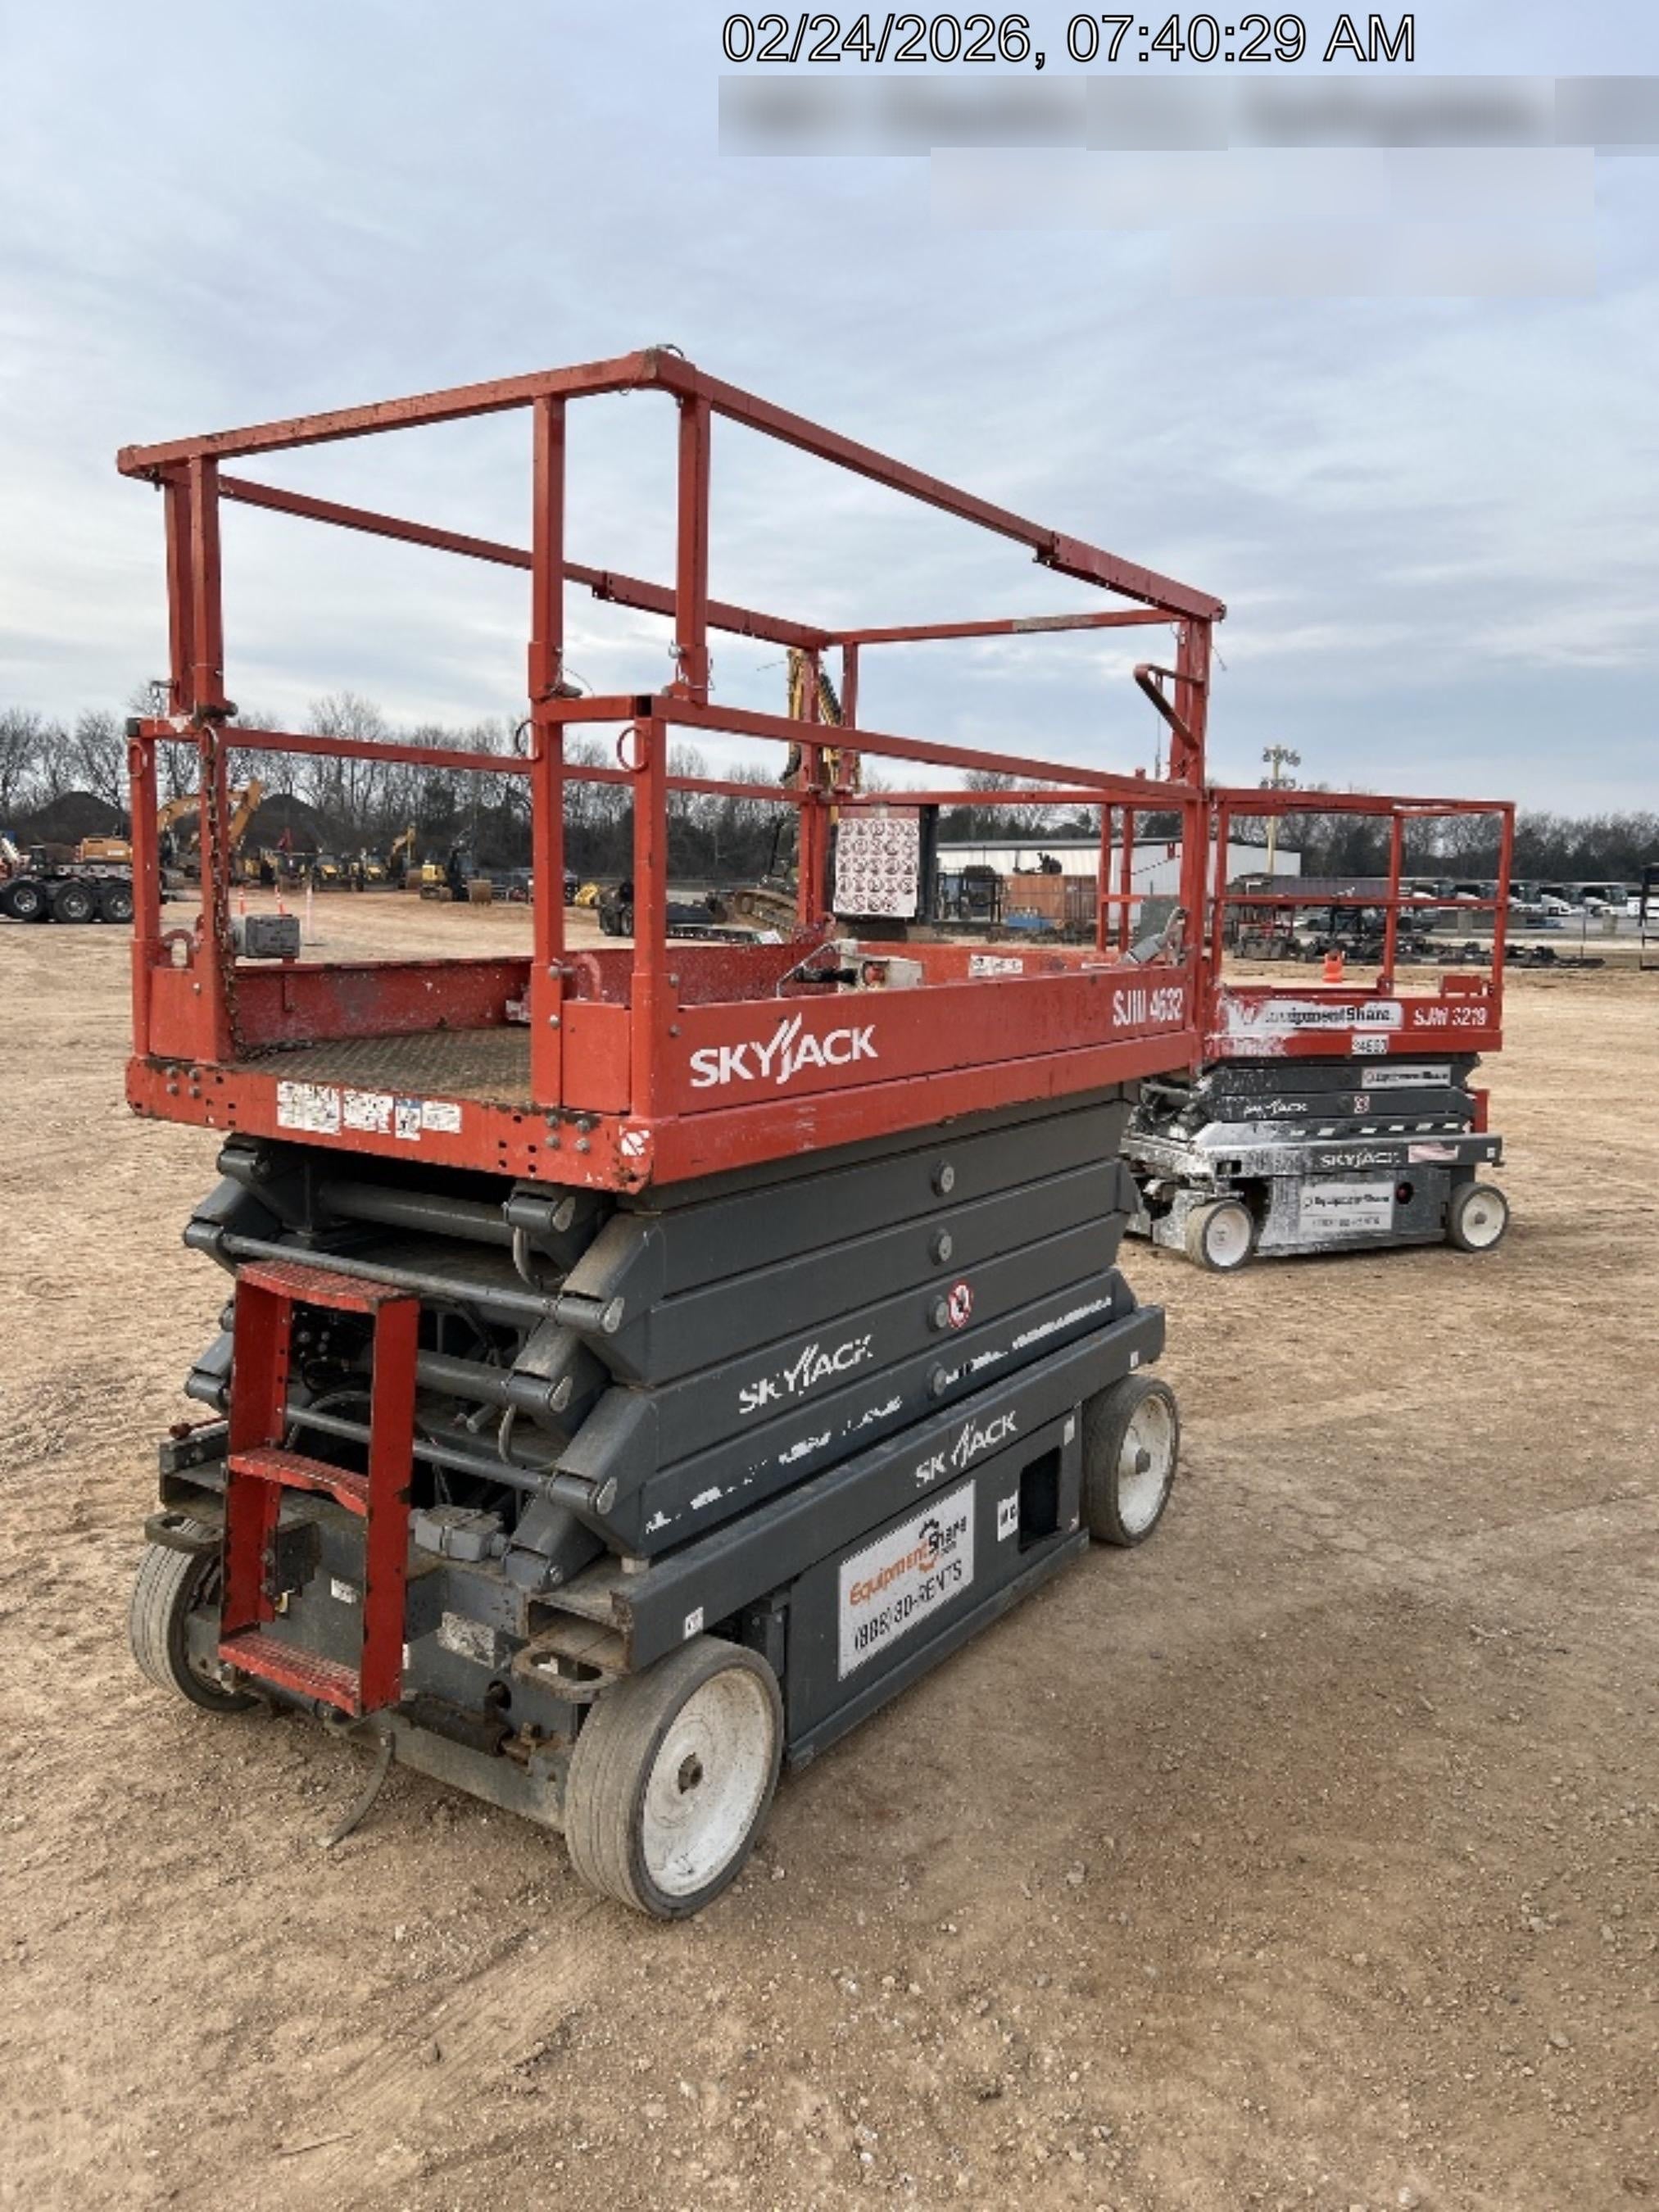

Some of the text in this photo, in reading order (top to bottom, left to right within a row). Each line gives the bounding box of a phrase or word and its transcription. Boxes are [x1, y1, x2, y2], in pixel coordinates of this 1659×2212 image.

[1149, 987, 1183, 1022] 4632
[690, 1012, 878, 1087] SKYJACK
[739, 1334, 874, 1414] SKYJACK
